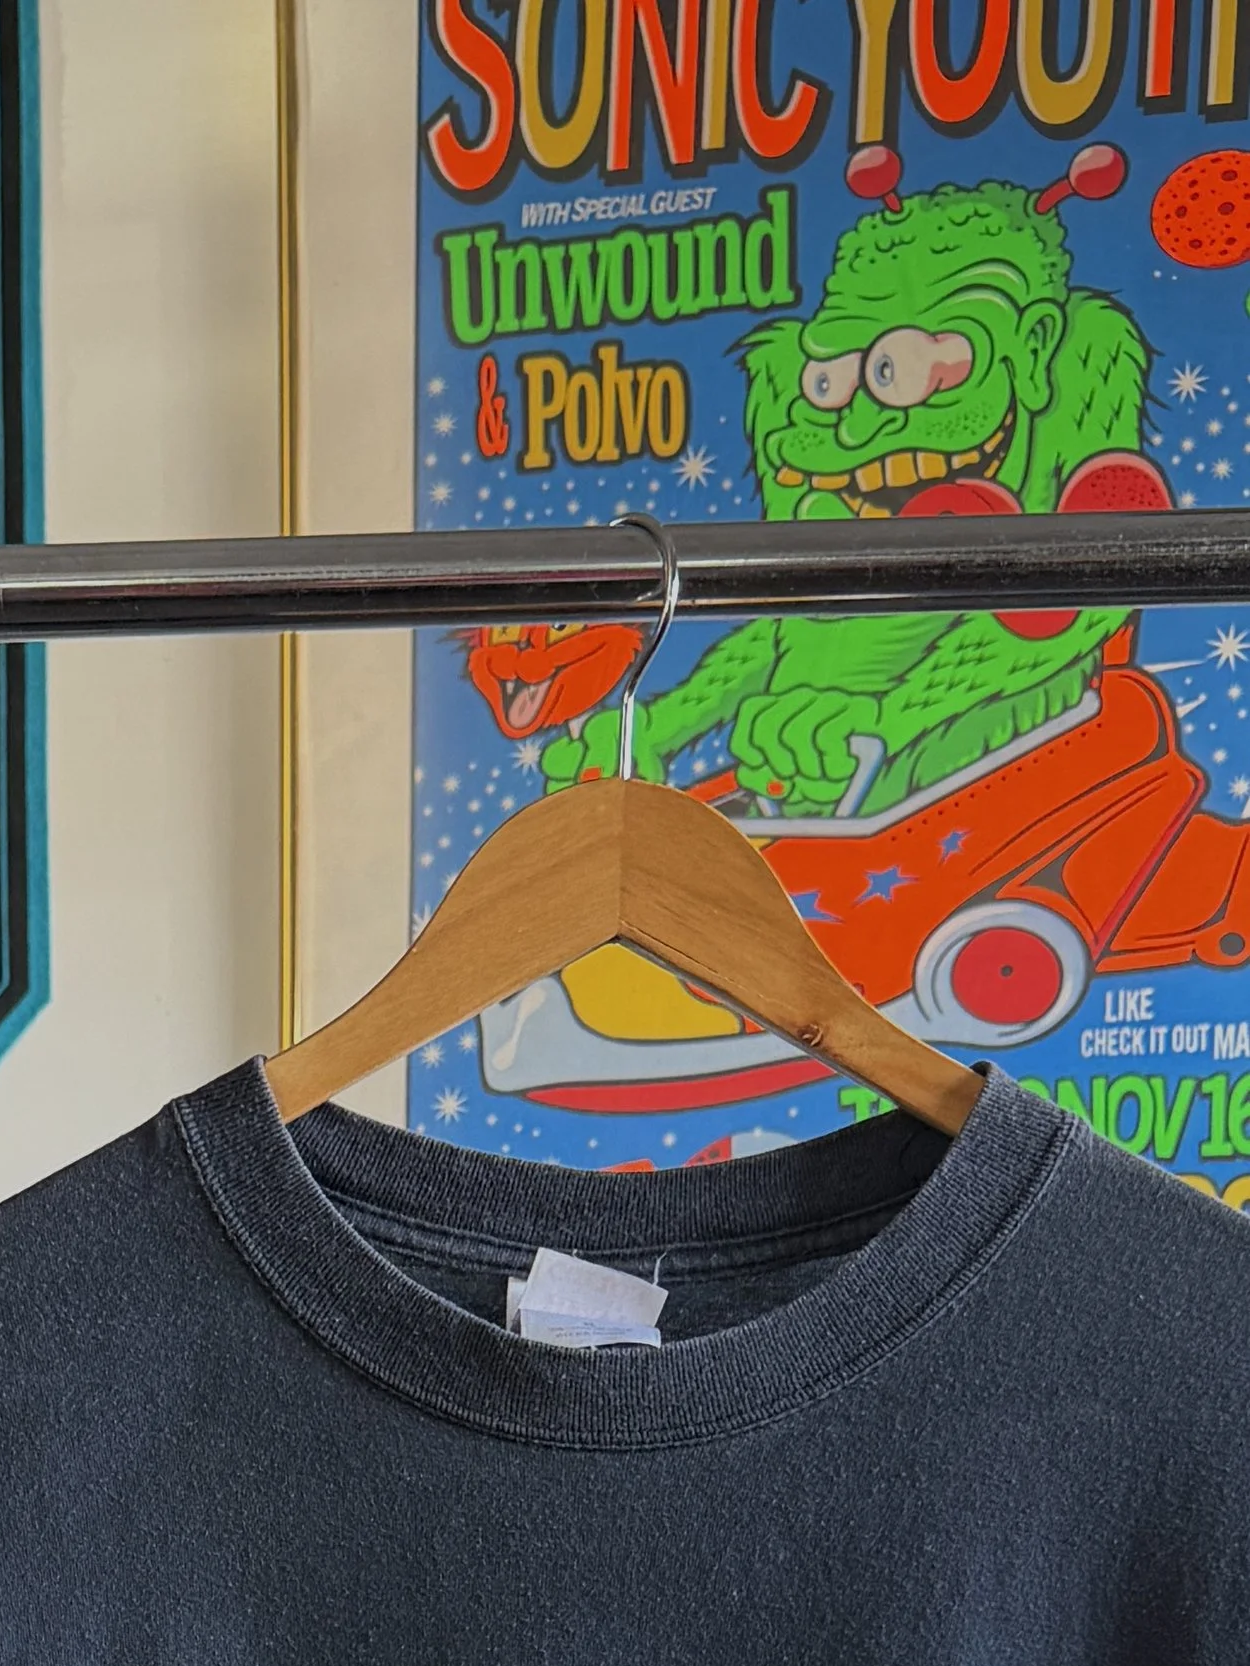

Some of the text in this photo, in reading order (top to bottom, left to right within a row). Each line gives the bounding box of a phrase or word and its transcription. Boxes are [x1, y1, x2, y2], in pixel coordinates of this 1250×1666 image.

[428, 0, 818, 190] SONIC
[521, 187, 717, 229] WITH SPECIAL GUEST
[442, 190, 795, 344] Unwound
[477, 344, 687, 469] & Polvo
[1081, 1026, 1146, 1058] CHECK
[1149, 1024, 1168, 1055] IT
[1171, 1021, 1211, 1054] OUT
[1103, 987, 1155, 1024] LIKE
[1057, 1074, 1197, 1160] NOV
